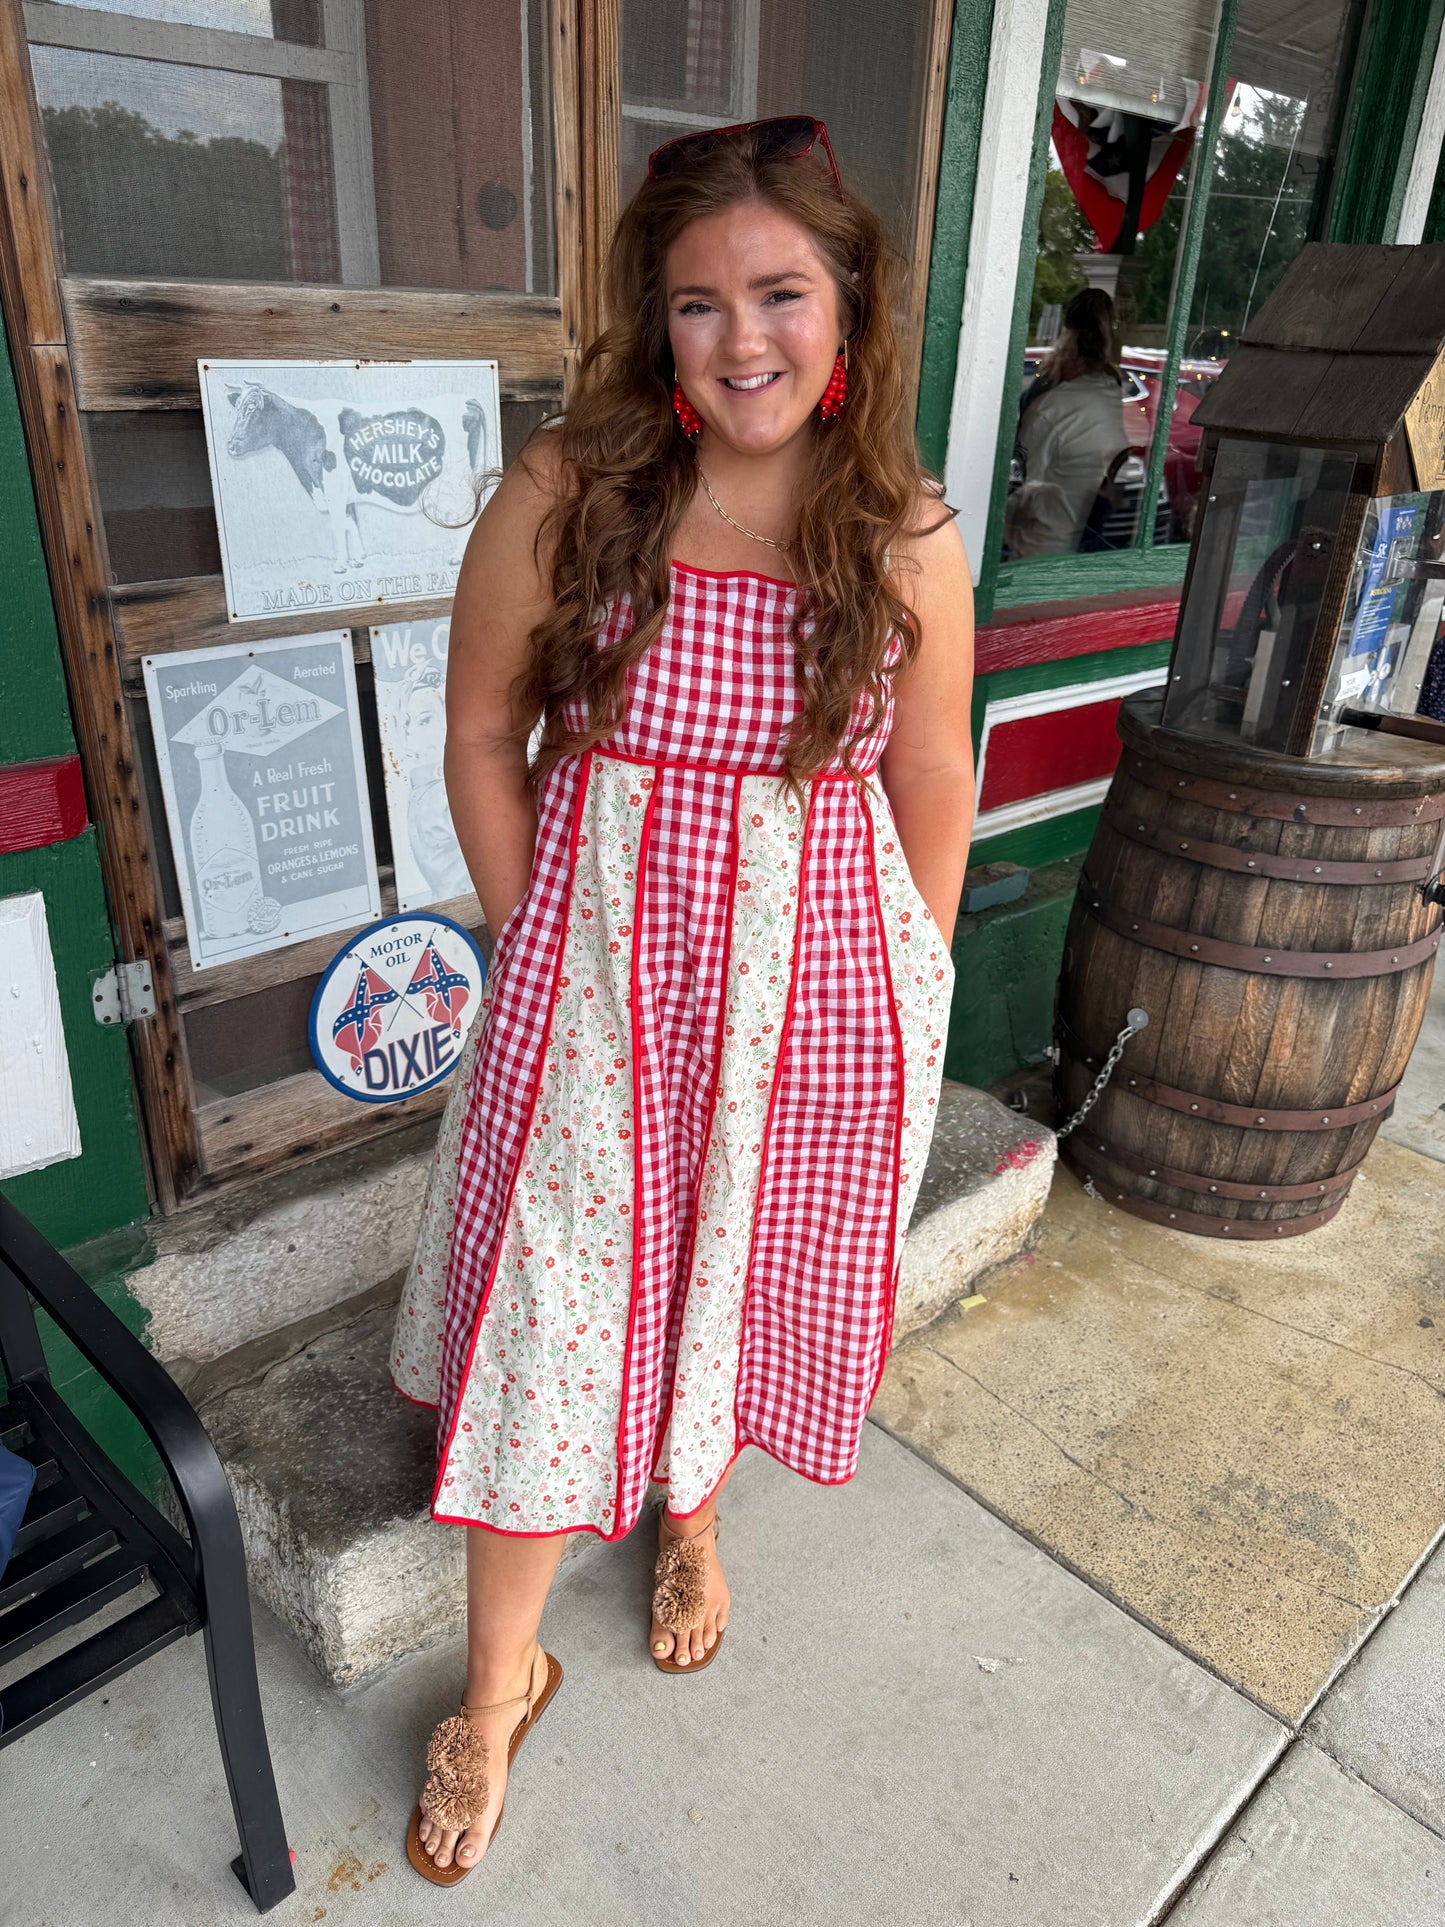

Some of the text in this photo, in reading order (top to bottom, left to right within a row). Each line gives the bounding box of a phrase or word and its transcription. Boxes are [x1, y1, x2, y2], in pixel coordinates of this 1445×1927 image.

[1418, 381, 1445, 423] Penn
[349, 419, 440, 450] HERSHEY'S
[372, 444, 424, 464] MILK
[351, 456, 442, 487] CHOCOLATE
[263, 583, 334, 610] MADE
[339, 579, 373, 600] ON
[377, 574, 422, 597] THE
[380, 629, 427, 668] We
[294, 662, 337, 680] Aerated
[165, 682, 217, 703] Sparkling
[207, 698, 321, 738] Or-Lem
[253, 757, 332, 787] A Real Fresh
[257, 782, 336, 817] FRUIT
[261, 807, 341, 842] DRINK
[267, 855, 311, 875] ORANGES
[319, 844, 359, 862] LEMONS
[283, 839, 333, 856] FRESH RIPE
[281, 862, 344, 884] & CANE SUGAR
[370, 932, 423, 958] MOTOR
[386, 952, 411, 968] OIL
[363, 1022, 454, 1091] DIXIE
